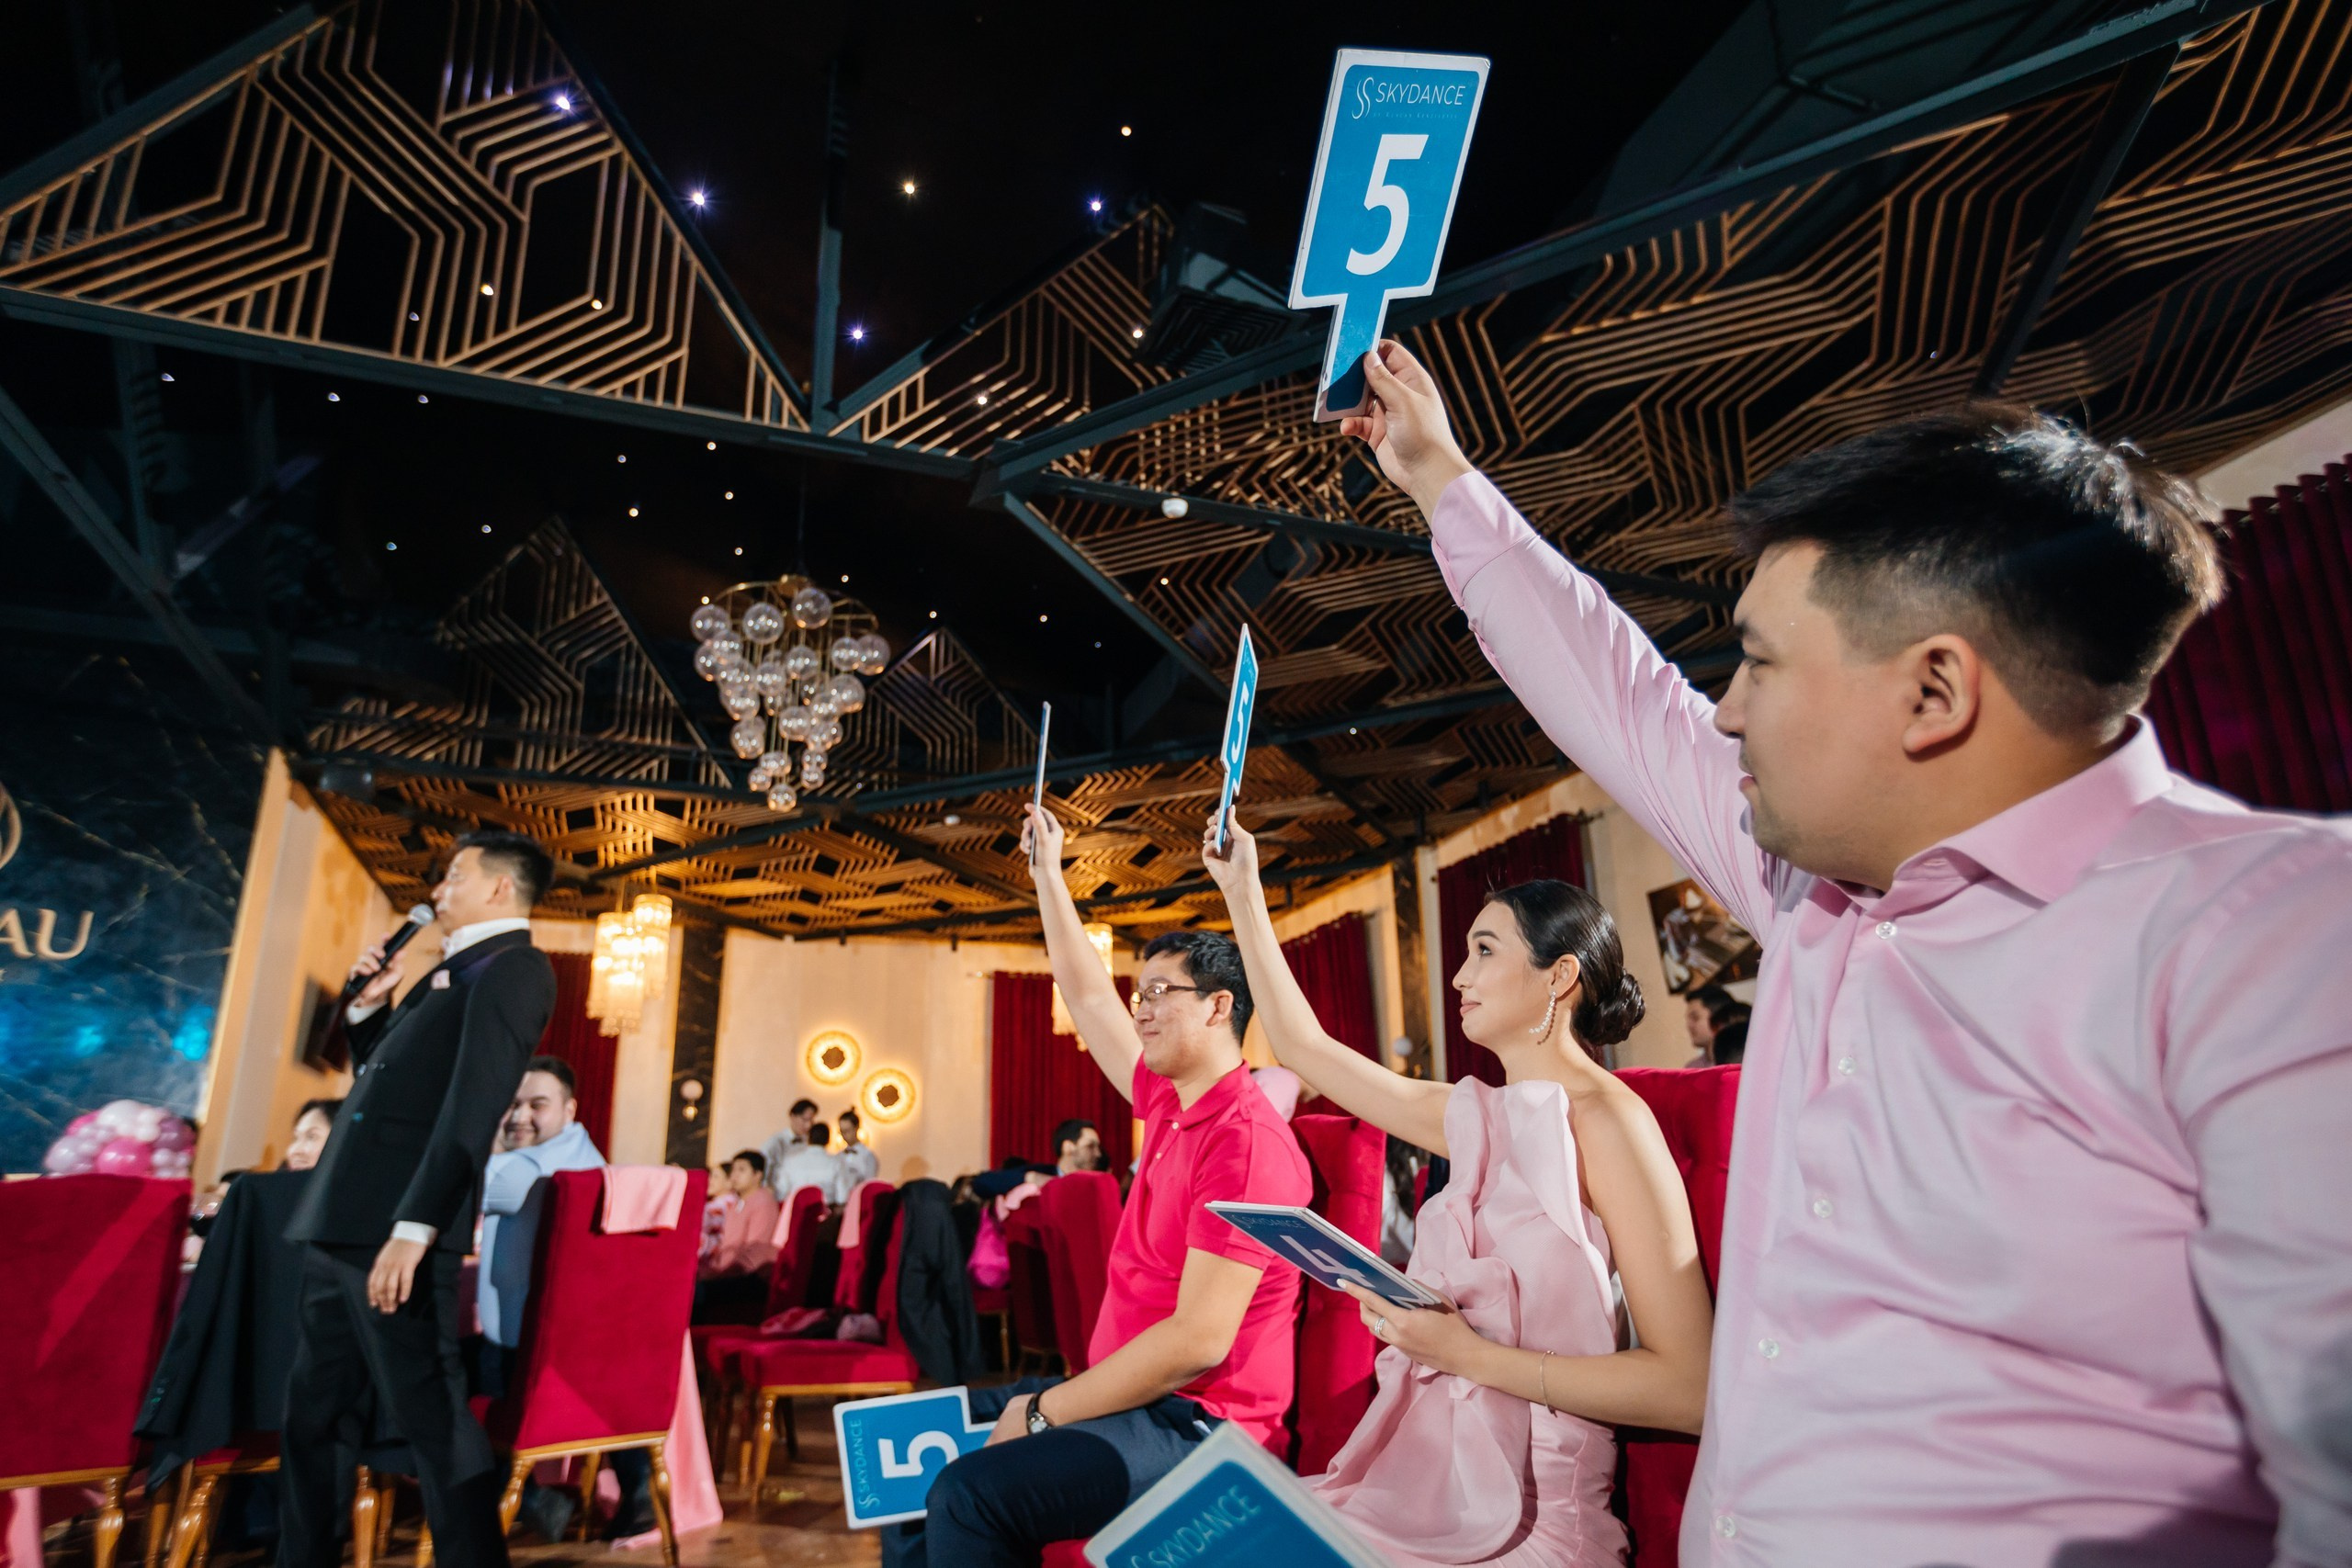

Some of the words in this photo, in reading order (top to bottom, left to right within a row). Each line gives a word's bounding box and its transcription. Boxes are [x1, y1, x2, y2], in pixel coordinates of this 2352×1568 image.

[1375, 82, 1466, 106] SKYDANCE
[1346, 134, 1430, 276] 5
[1231, 681, 1250, 763] 5
[1280, 1235, 1376, 1288] 4
[850, 1418, 870, 1492] SKYDANCE
[878, 1430, 960, 1479] 5
[1148, 1484, 1261, 1568] SKYDANCE
